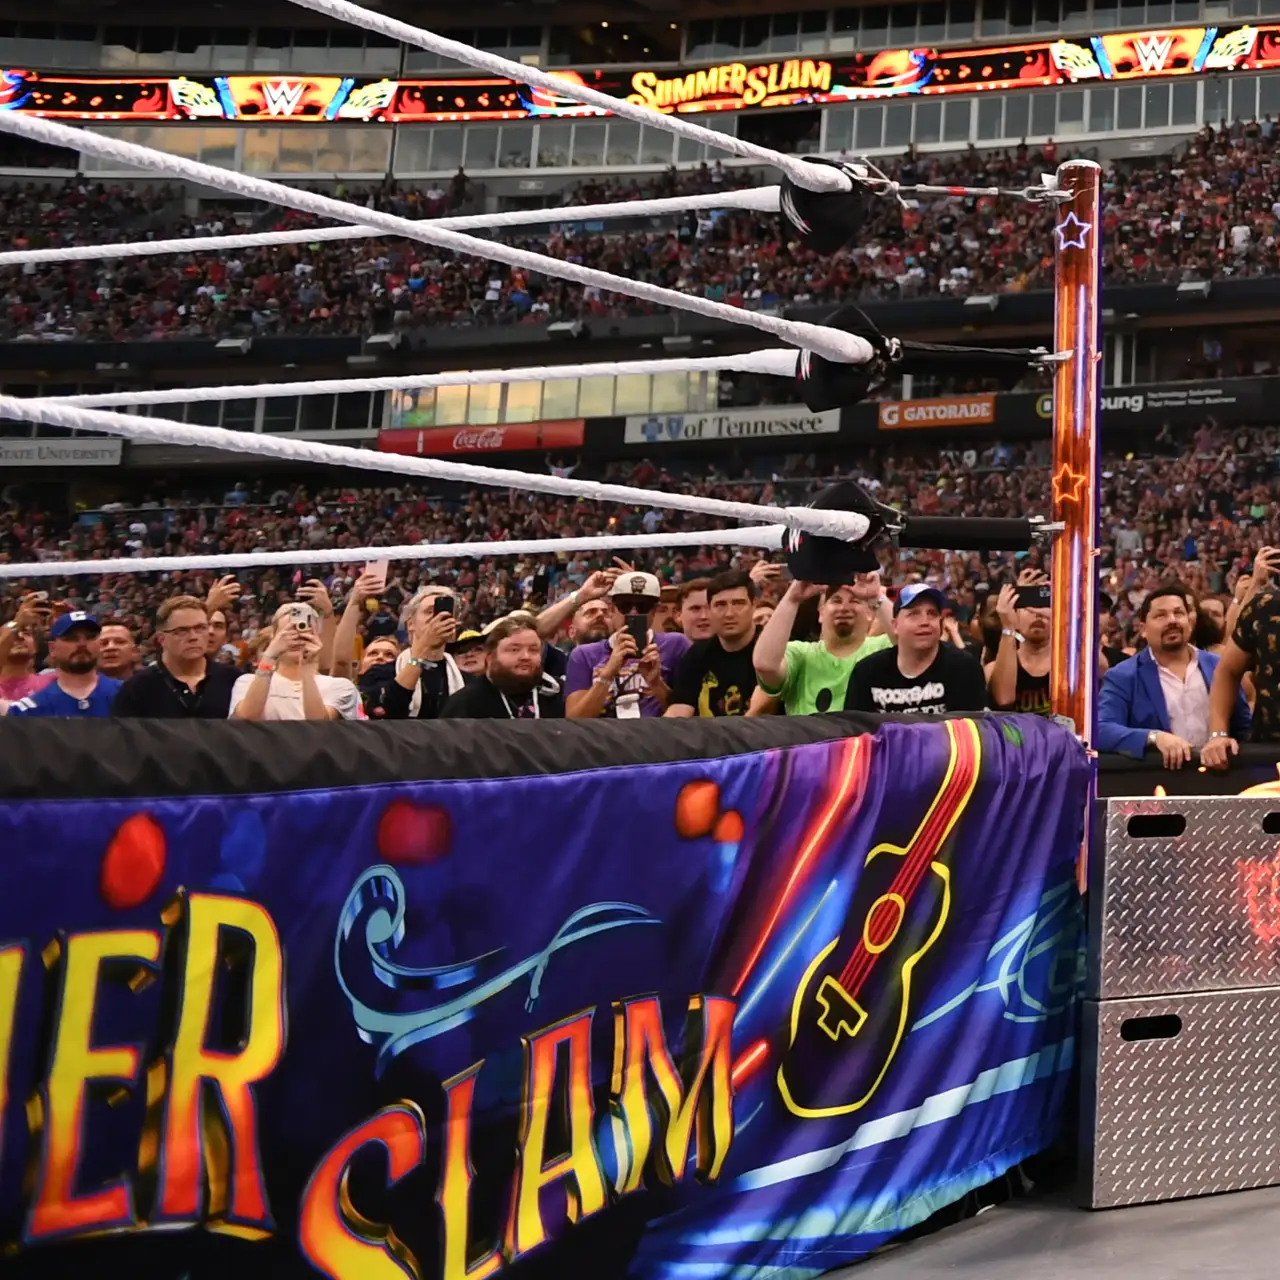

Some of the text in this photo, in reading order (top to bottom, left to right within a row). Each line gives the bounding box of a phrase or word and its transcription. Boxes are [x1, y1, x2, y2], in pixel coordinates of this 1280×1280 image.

[904, 402, 992, 421] GATORADE
[1099, 393, 1143, 412] oung
[684, 415, 824, 438] of Tennessee
[0, 886, 287, 1240] ER
[299, 991, 737, 1280] SLAM
